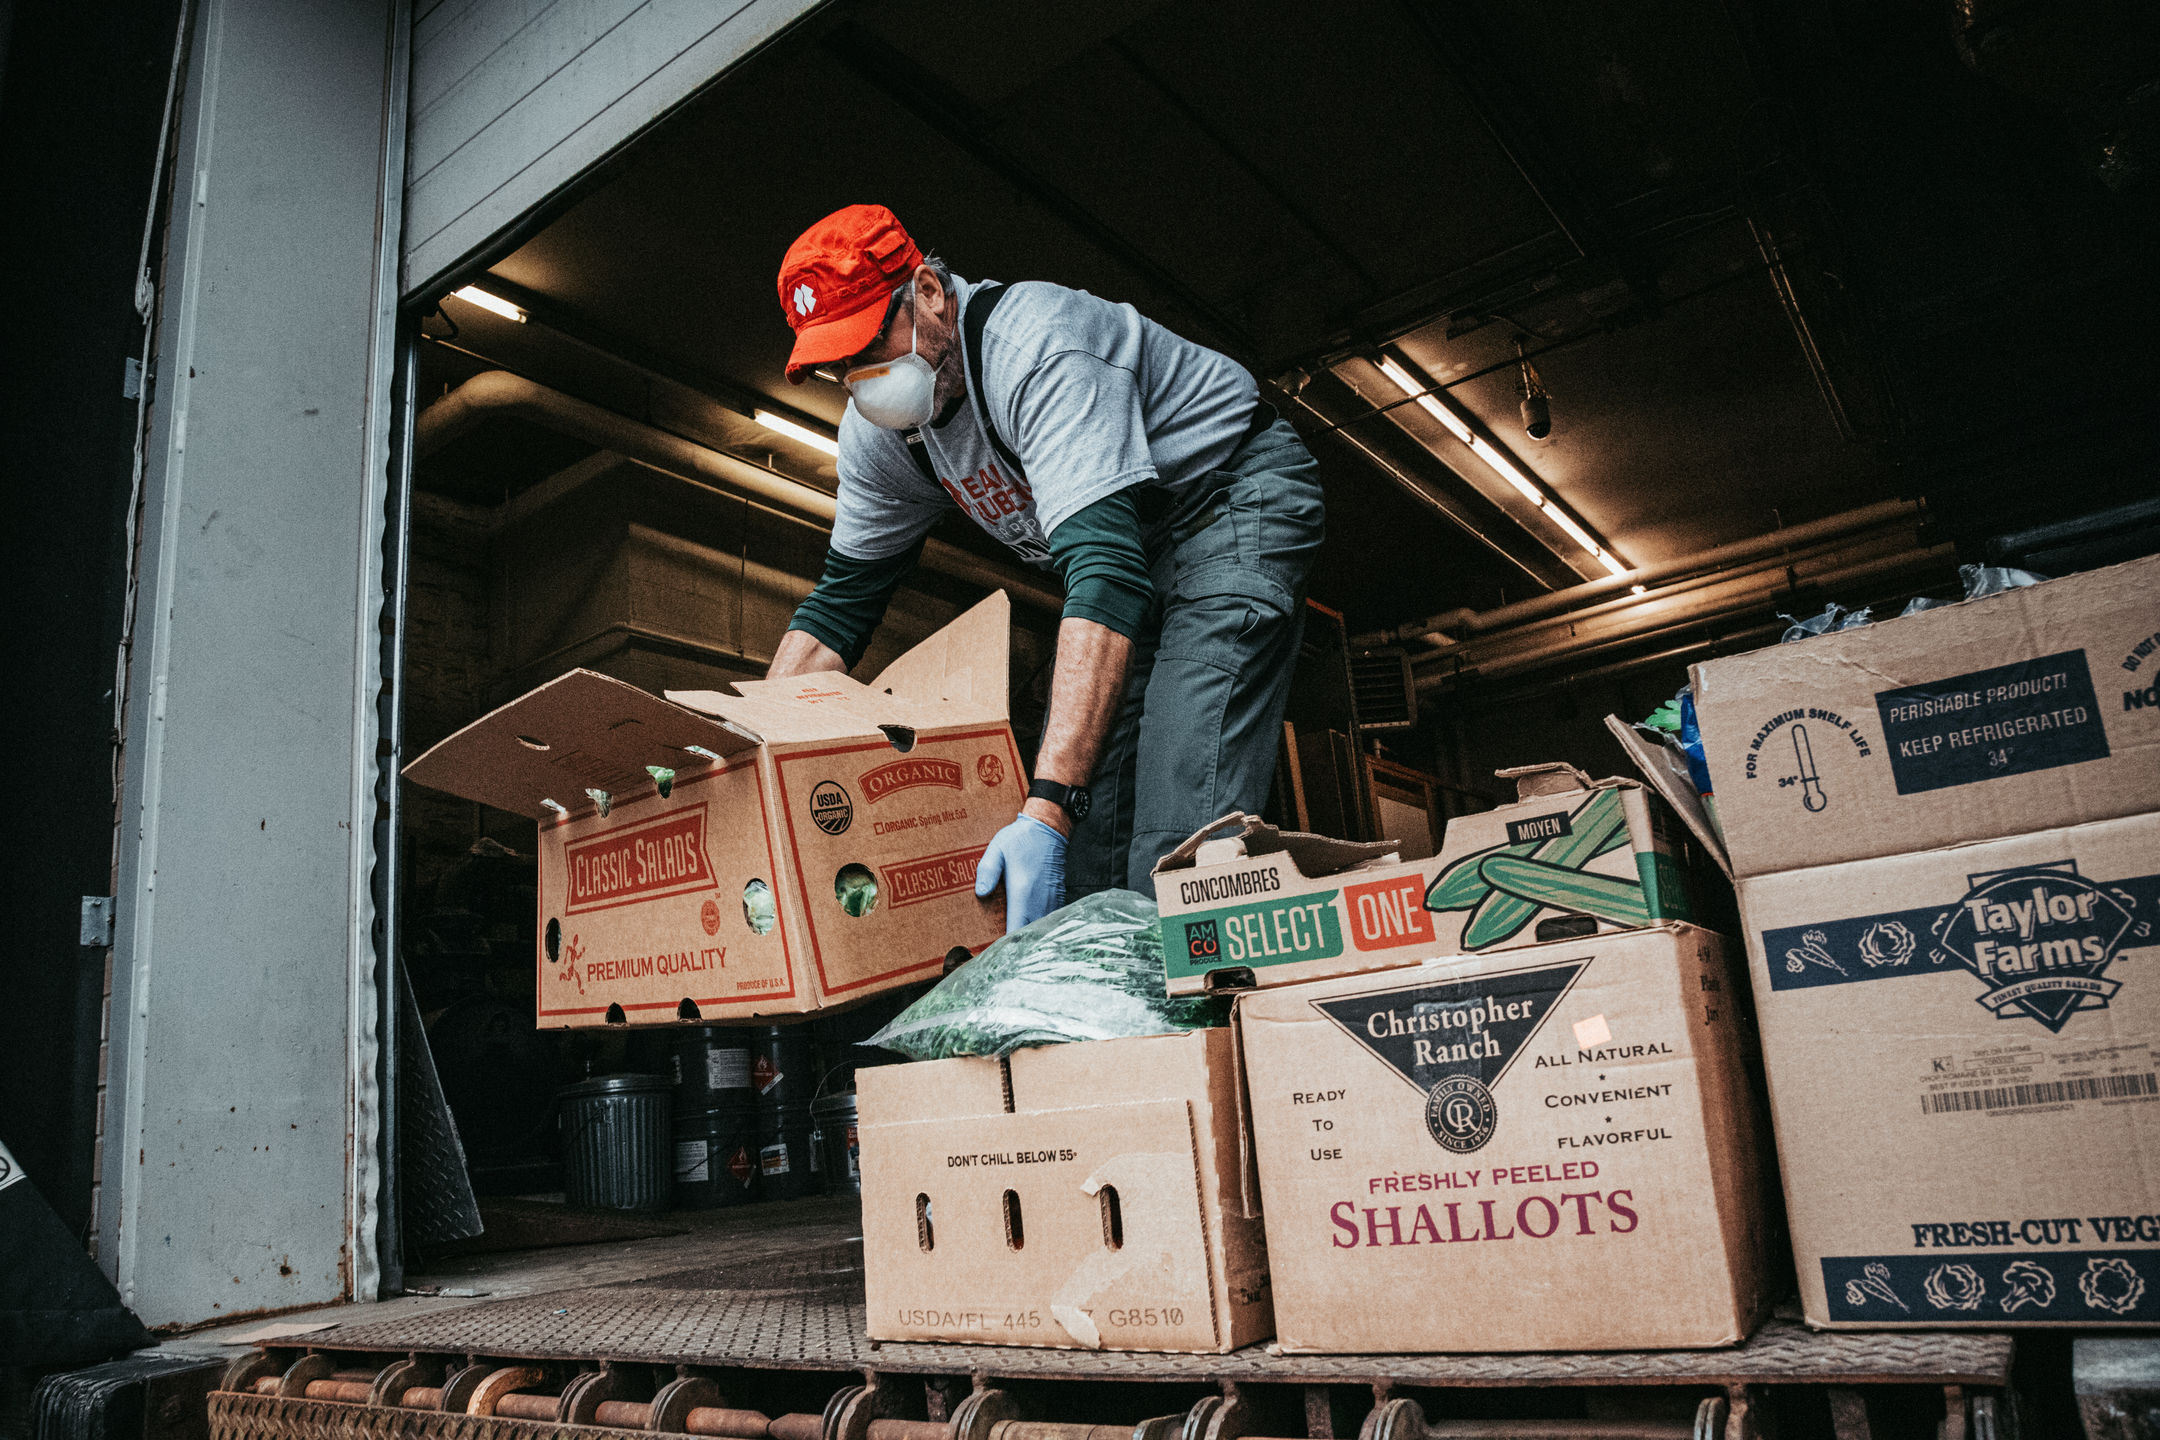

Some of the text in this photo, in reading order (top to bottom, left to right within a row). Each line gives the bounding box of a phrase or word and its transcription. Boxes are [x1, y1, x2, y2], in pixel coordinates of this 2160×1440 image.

[2122, 637, 2157, 672] DO NOT
[1890, 672, 2067, 724] PERISHABLE PRODUCT!
[1745, 708, 1871, 779] FOR MAXIMUM SHELF LIFE
[1900, 706, 2088, 758] KEEP REFRIGERATED
[869, 765, 956, 792] ORGANIC
[816, 792, 843, 807] USDA
[817, 808, 848, 821] ORGANIC
[885, 817, 918, 833] ORGANIC
[919, 814, 942, 828] Spring
[943, 810, 955, 823] Mix
[1517, 818, 1562, 841] MOYEN
[577, 832, 698, 897] CLASSIC SALADS
[894, 857, 980, 897] CLASSIC SALA
[1181, 867, 1280, 905] CONCOMBRES
[1225, 886, 1422, 960] SELECT ONE
[1964, 886, 2099, 941] Taylor
[587, 946, 727, 982] PREMIUM QUALITY
[1190, 956, 1222, 966] PRODUCE
[1973, 935, 2107, 977] Farms
[736, 979, 760, 990] PRODUCE
[762, 979, 768, 988] OF
[1992, 980, 2102, 1003] FINEST QUALITY SALADS
[1366, 995, 1534, 1041] Christopher
[1413, 1034, 1502, 1067] Ranch
[1535, 1041, 1673, 1070] ALL NATURAL
[1293, 1088, 1346, 1105] READY
[1431, 1081, 1491, 1118] FAMILY OWNED
[1544, 1084, 1672, 1109] CONVENIENT
[1310, 1147, 1343, 1162] USE
[1438, 1130, 1467, 1149] SINCE
[1557, 1127, 1672, 1149] FLAVORFUL
[947, 1154, 978, 1168] DON'T
[980, 1153, 1014, 1166] CHILL
[1016, 1150, 1057, 1164] BELOW
[1368, 1160, 1600, 1195] FRESHLY PEELED
[1330, 1188, 1640, 1249] SHALLOTS
[1911, 1215, 2160, 1248] FRESH-CUT VEG
[898, 1309, 993, 1331] USDA/FL
[1003, 1310, 1041, 1331] 445
[1109, 1307, 1185, 1328] G8510
